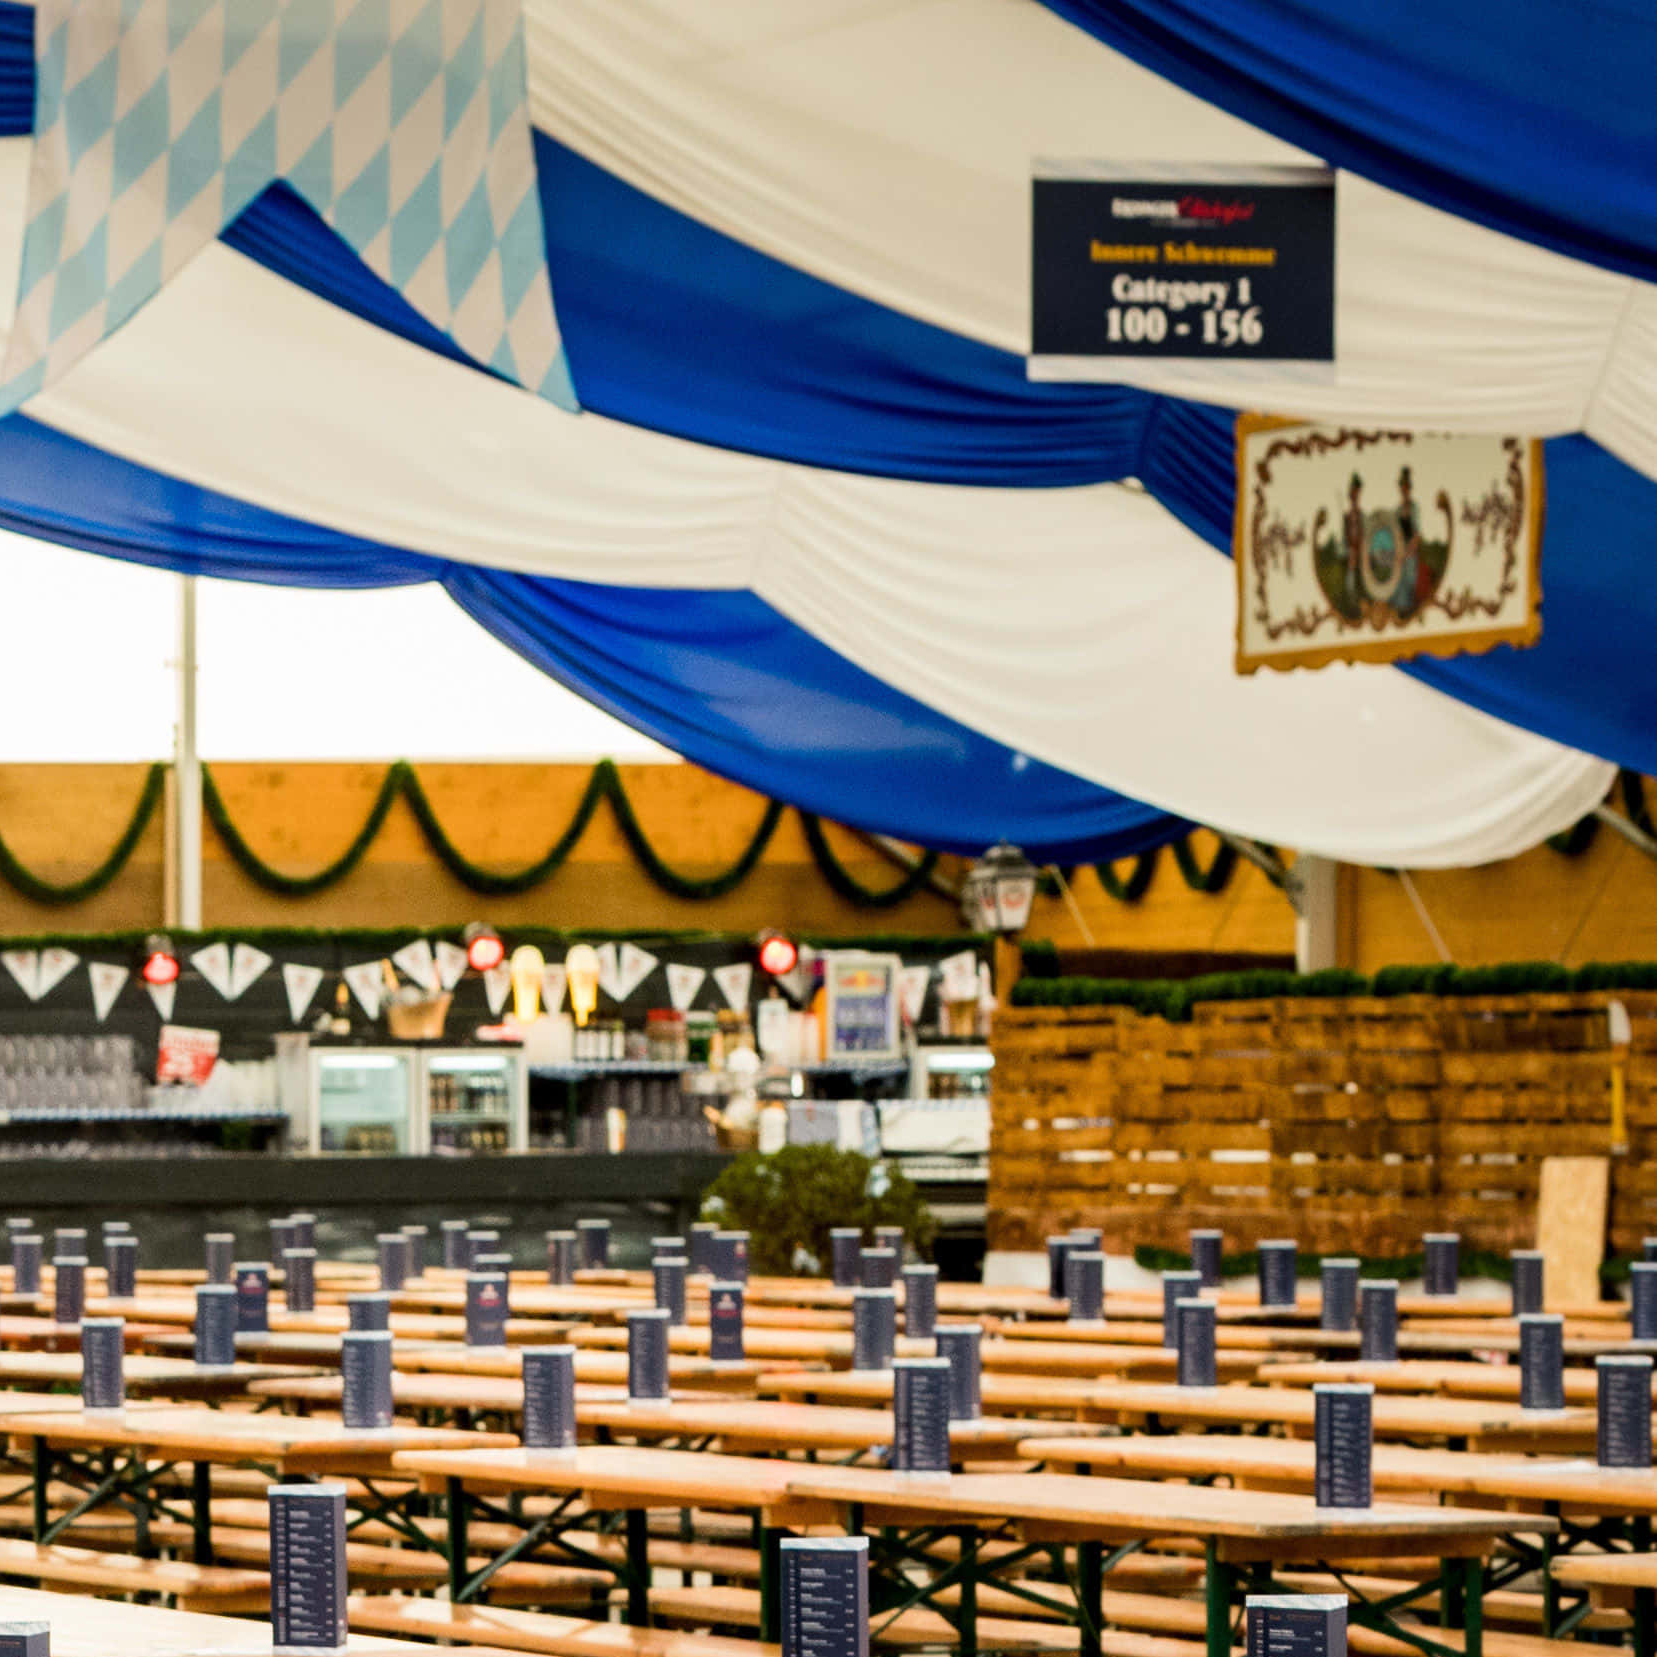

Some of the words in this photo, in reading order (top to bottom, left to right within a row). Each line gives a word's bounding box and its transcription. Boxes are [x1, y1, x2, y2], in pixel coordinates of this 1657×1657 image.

[1112, 274, 1229, 311] Category
[1238, 277, 1252, 305] 1
[1106, 307, 1167, 343] 100
[1202, 306, 1264, 346] 156
